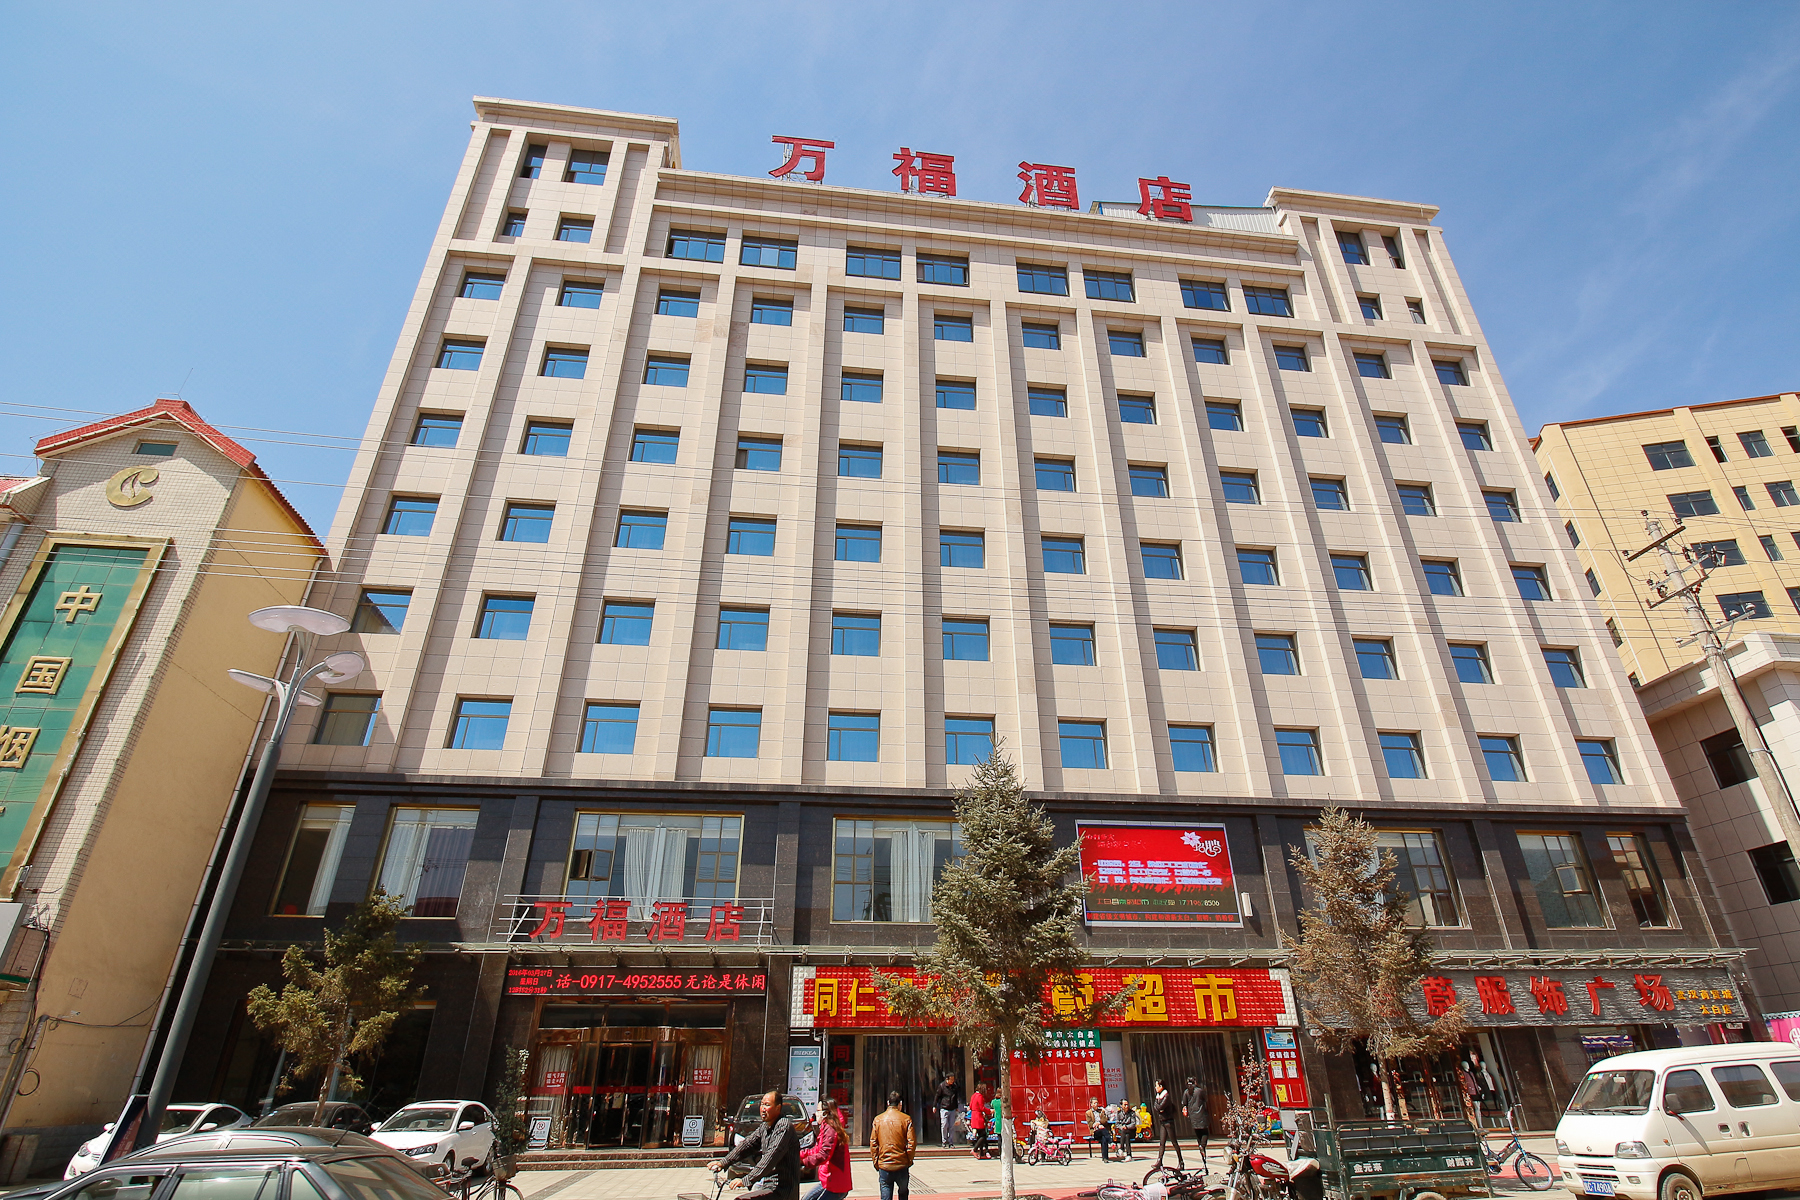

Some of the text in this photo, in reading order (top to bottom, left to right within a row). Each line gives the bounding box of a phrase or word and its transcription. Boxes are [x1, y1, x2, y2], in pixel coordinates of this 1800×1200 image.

[768, 135, 1193, 223] 万福酒店
[0, 585, 103, 815] 中国烟
[528, 899, 746, 942] 万福酒店
[519, 977, 539, 986] 星期日
